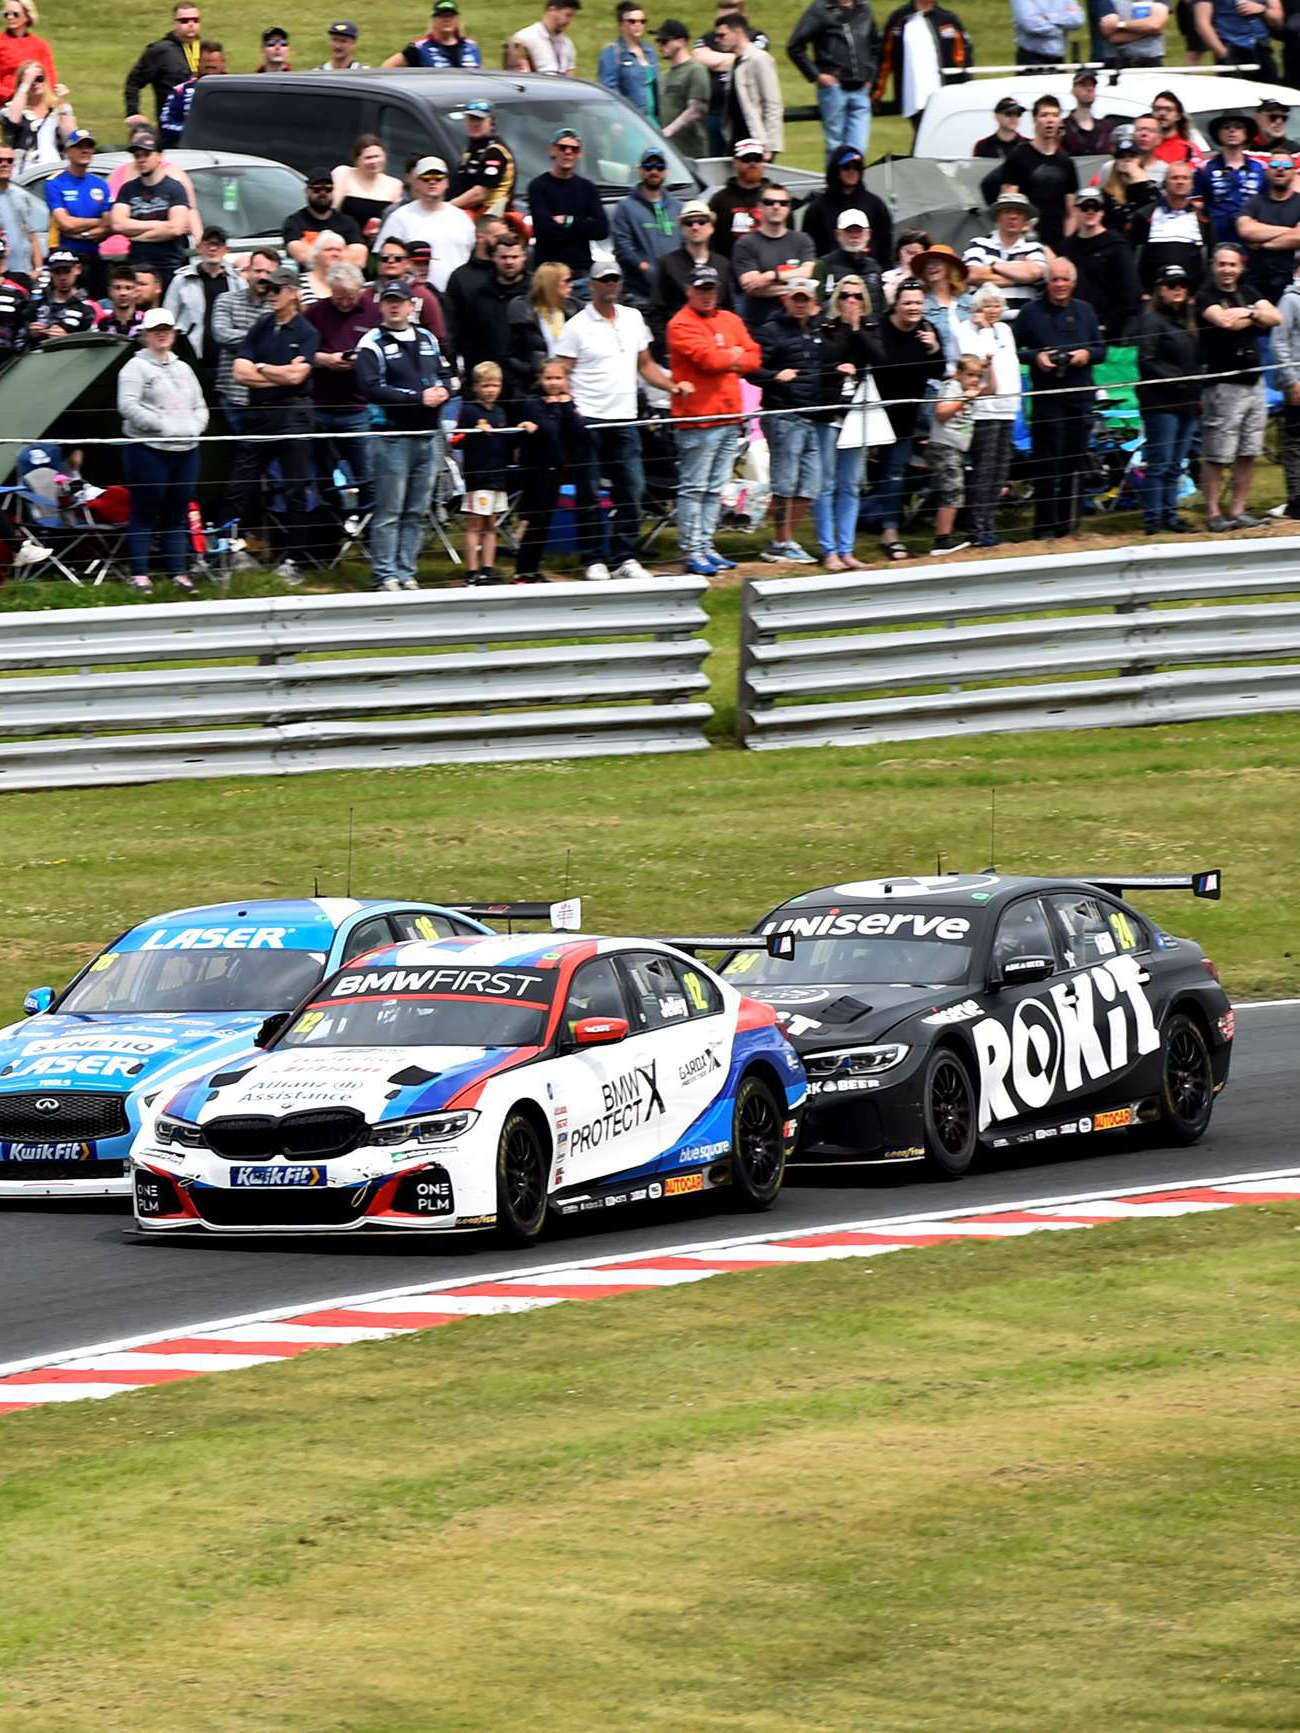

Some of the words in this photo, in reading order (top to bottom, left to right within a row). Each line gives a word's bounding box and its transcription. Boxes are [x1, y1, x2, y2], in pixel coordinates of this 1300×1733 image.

[1108, 912, 1136, 949] 24
[140, 927, 286, 950] LASER
[294, 1012, 325, 1033] 12
[36, 1038, 154, 1052] SYNETIQ
[249, 1080, 328, 1091] Allianz
[602, 1066, 641, 1112] BMW
[837, 1079, 880, 1091] BEER
[239, 1091, 352, 1103] Assistance
[1095, 1109, 1132, 1129] AUTOCAR
[570, 1098, 642, 1157] PROTECT
[137, 1185, 158, 1197] ONE
[417, 1183, 450, 1195] ONE
[665, 1175, 704, 1195] AUTOCAR
[138, 1198, 160, 1211] PLM
[418, 1199, 450, 1210] PLM
